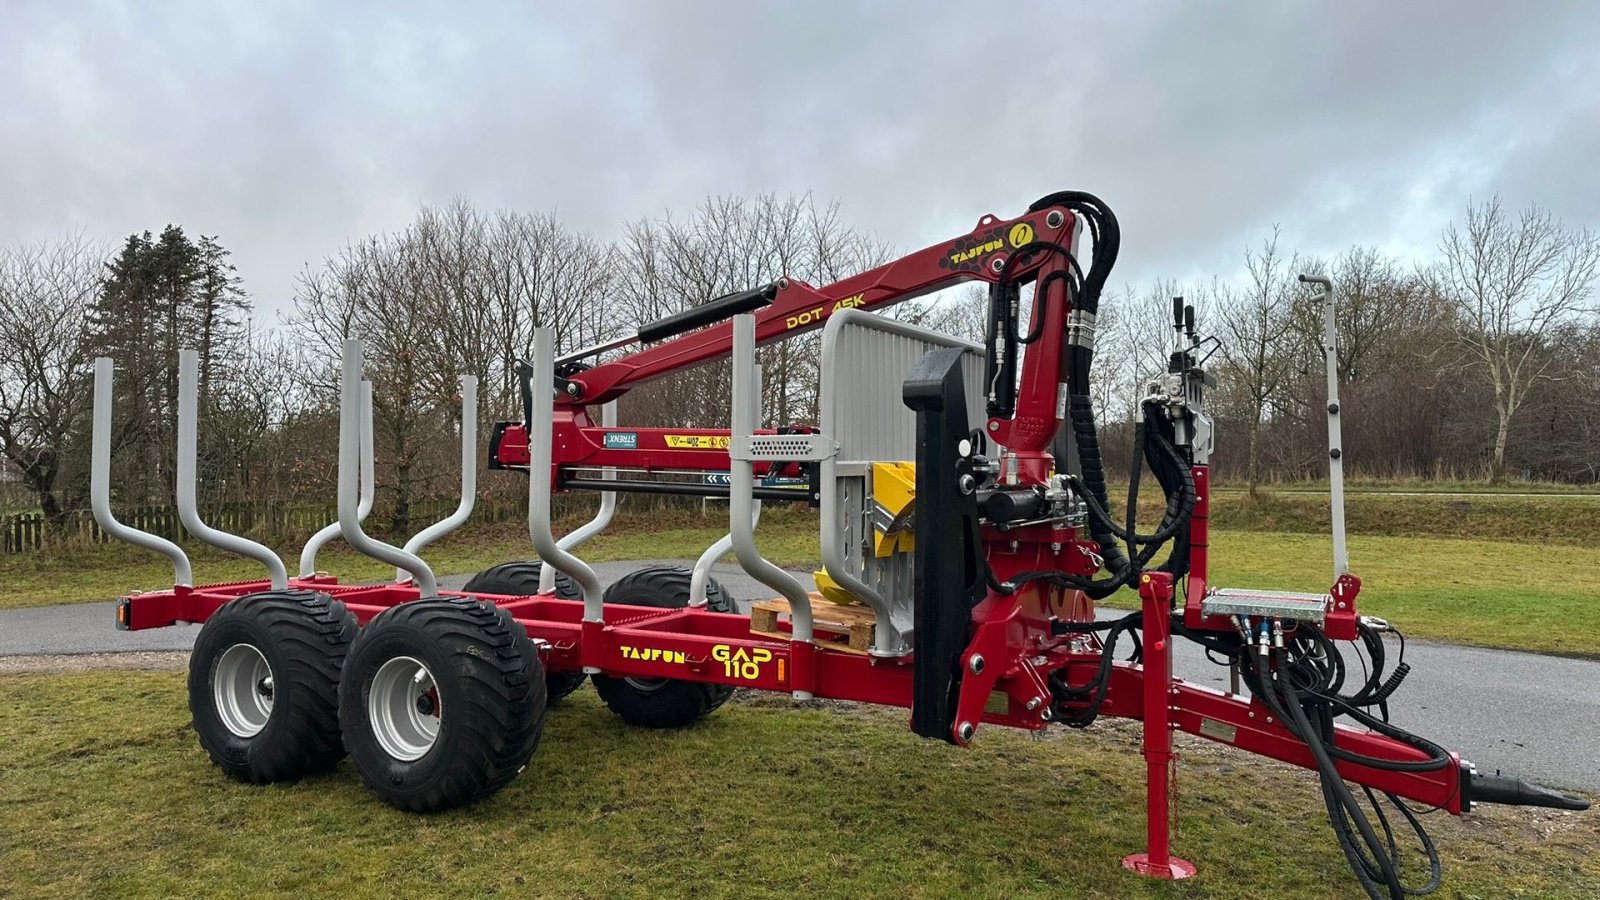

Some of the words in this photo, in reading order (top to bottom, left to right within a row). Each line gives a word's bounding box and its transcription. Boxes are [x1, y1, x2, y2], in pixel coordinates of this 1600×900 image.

[951, 239, 1003, 264] TAJFUN
[786, 307, 824, 330] DOT
[831, 293, 866, 314] 45K
[620, 646, 685, 664] TAJFUN
[712, 644, 772, 664] GAP
[724, 661, 760, 680] 110
